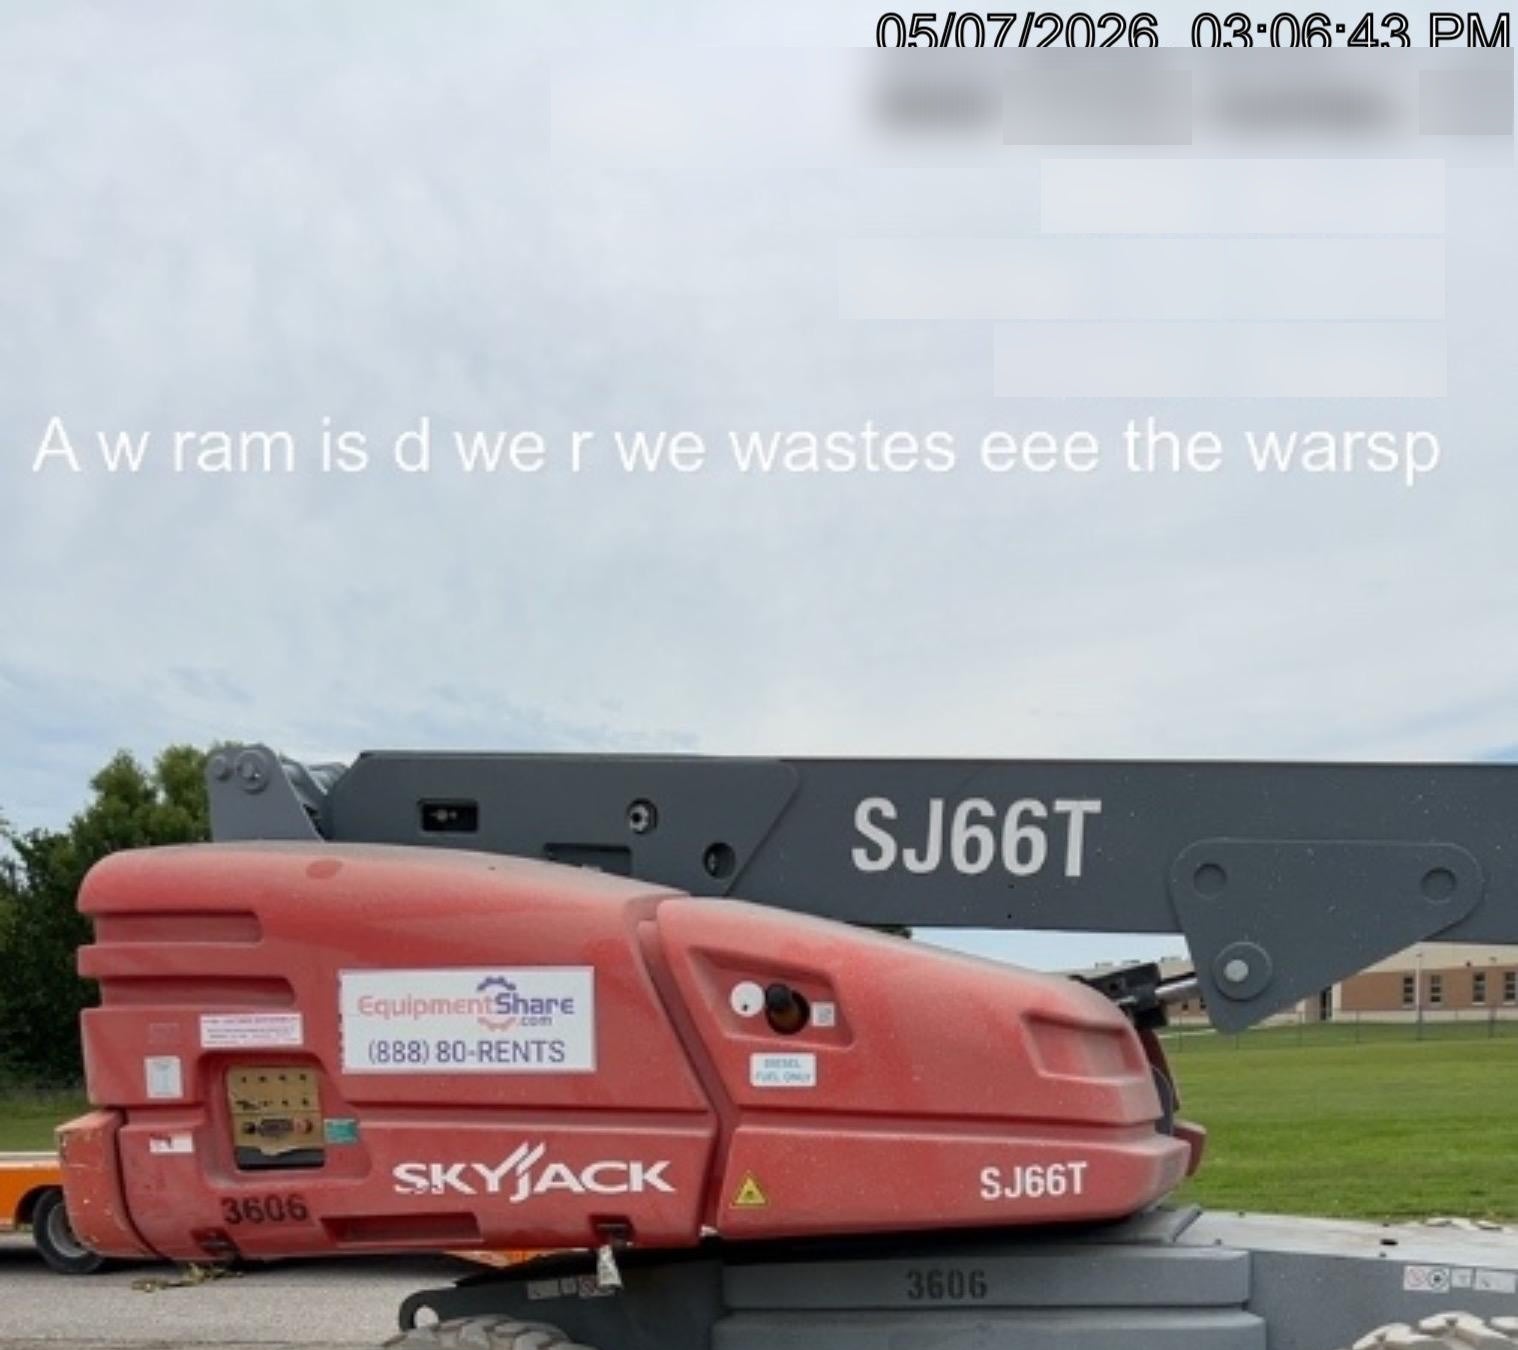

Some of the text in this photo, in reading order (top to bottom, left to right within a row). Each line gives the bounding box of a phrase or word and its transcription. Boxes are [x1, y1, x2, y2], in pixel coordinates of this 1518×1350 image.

[851, 797, 1102, 877] SJ66T
[358, 992, 575, 1020] EquipmentShare
[368, 1040, 566, 1064] (888) 80-RENTS
[392, 1142, 676, 1203] SKYJACK
[980, 1161, 1088, 1200] SJ66T
[221, 1193, 309, 1225] 3606
[906, 1268, 989, 1300] 3606
